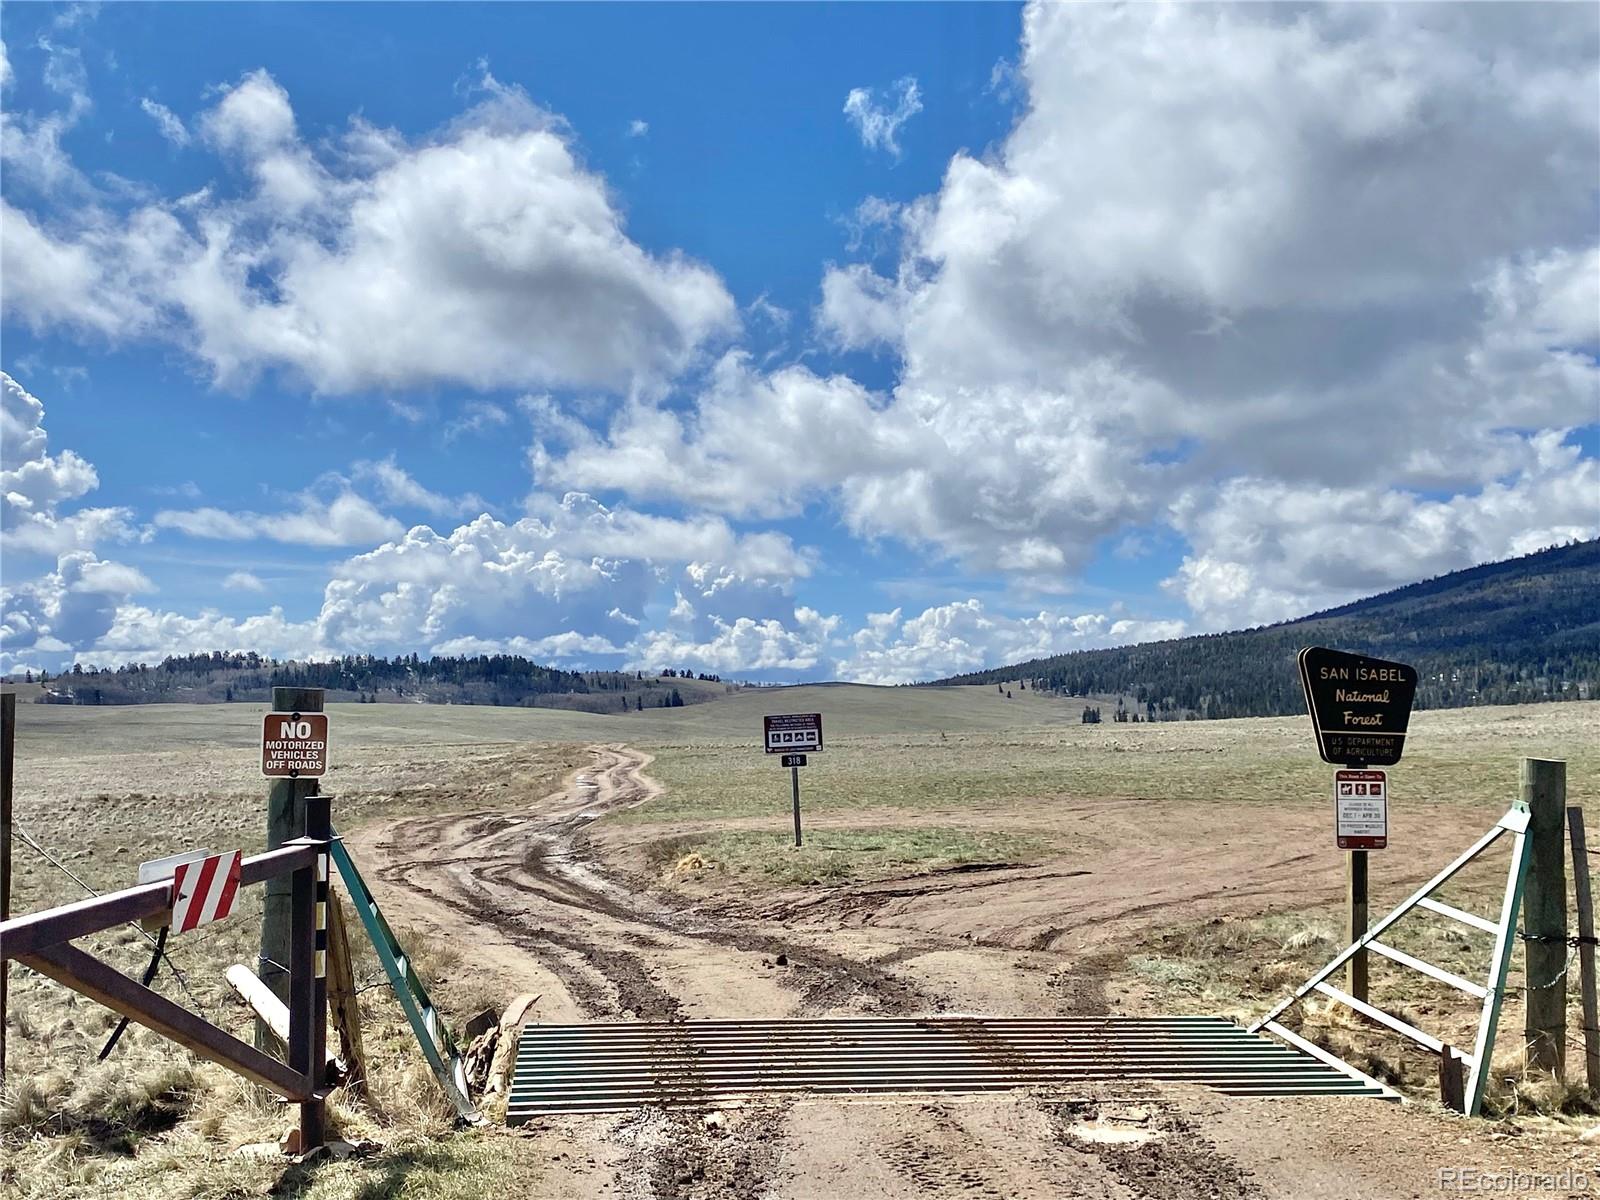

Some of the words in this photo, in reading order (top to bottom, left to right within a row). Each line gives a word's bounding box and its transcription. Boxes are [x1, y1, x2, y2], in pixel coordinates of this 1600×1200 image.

[1320, 667, 1349, 680] SAN
[1356, 668, 1406, 682] ISABEL
[1335, 688, 1390, 703] National
[1343, 711, 1384, 726] Forest
[280, 721, 312, 739] NO
[265, 741, 325, 750] MOTORIZED
[1348, 737, 1395, 747] DEPARTMENT
[271, 751, 319, 760] VEHICLES
[1333, 748, 1342, 756] OF
[1346, 748, 1393, 757] AGRICULTURE
[266, 760, 286, 769] OFF
[287, 760, 323, 770] ROADS
[787, 756, 801, 766] 318
